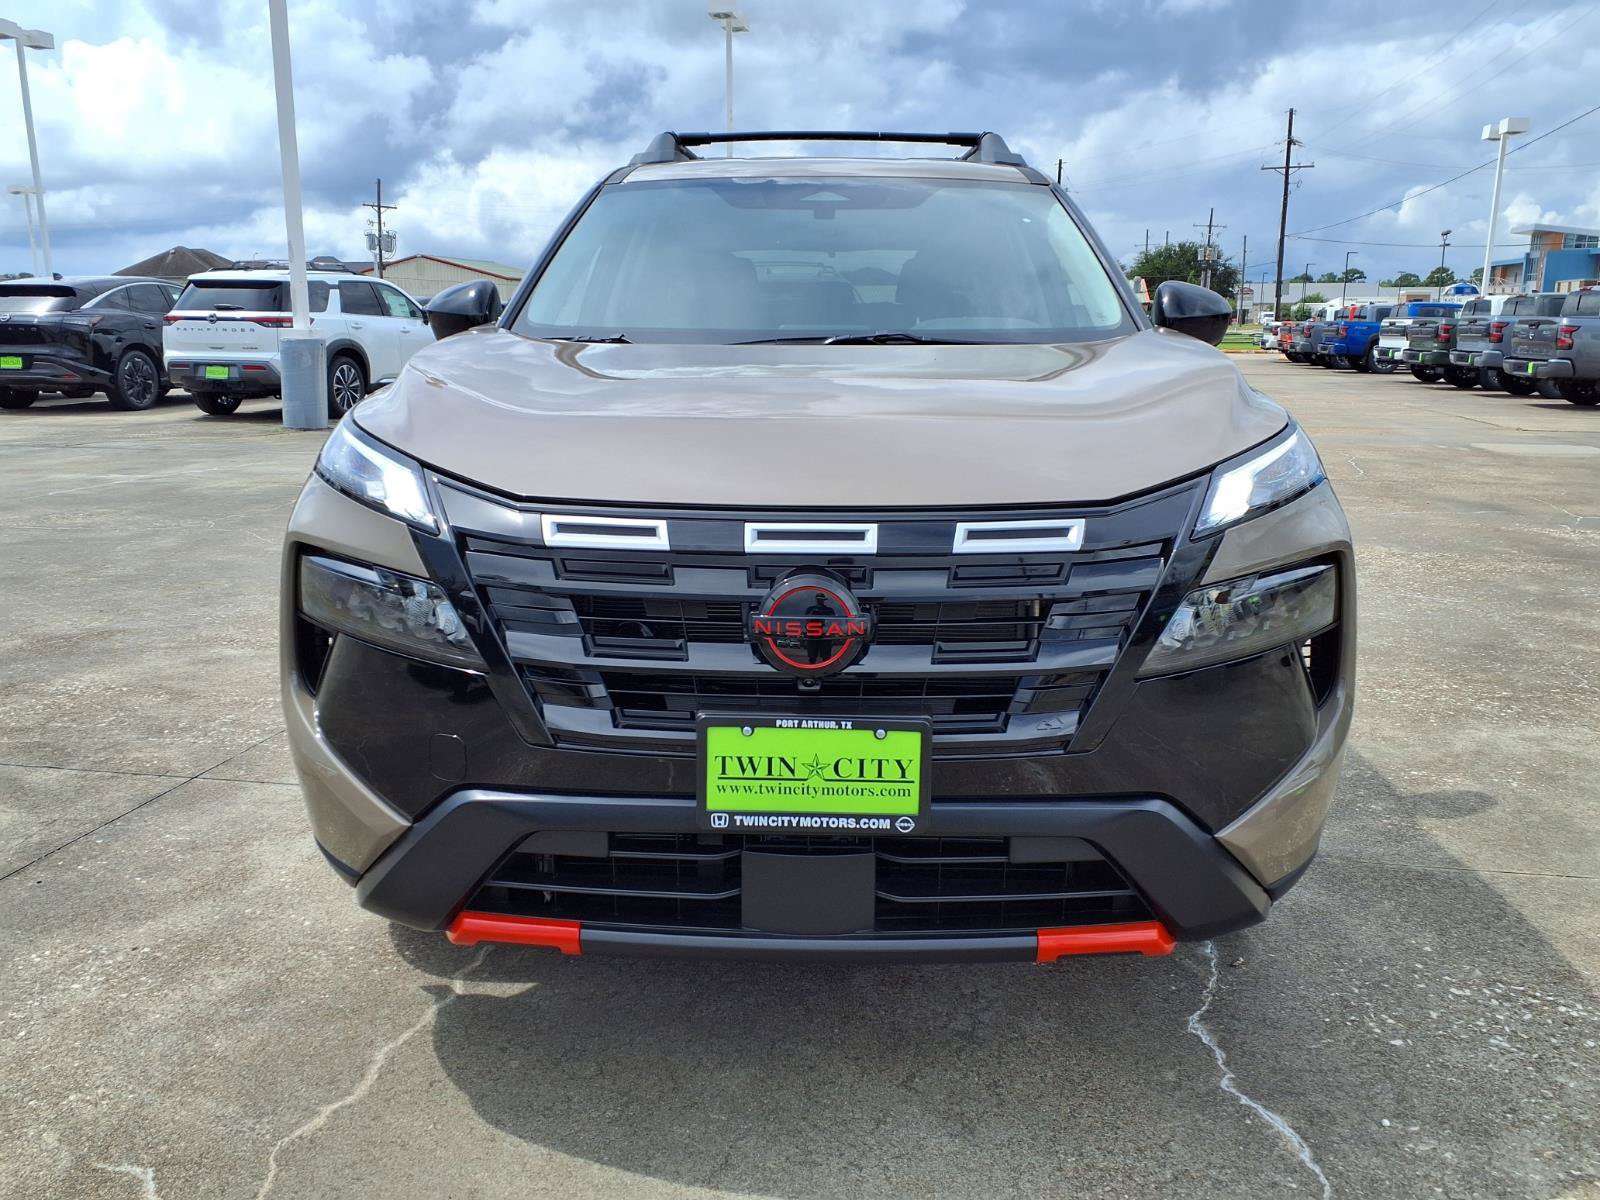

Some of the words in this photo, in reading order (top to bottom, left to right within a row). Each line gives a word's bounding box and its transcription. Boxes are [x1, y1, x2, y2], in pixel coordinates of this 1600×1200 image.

[753, 621, 865, 636] NISSAN
[776, 719, 798, 728] PORT
[801, 720, 839, 729] ARTHUR,
[840, 721, 853, 730] TX
[714, 755, 797, 776] TWIN
[833, 757, 913, 779] CITY
[716, 783, 911, 799] www.twincitymotors.com
[734, 815, 891, 830] TWINCITYMOTORS.COM
